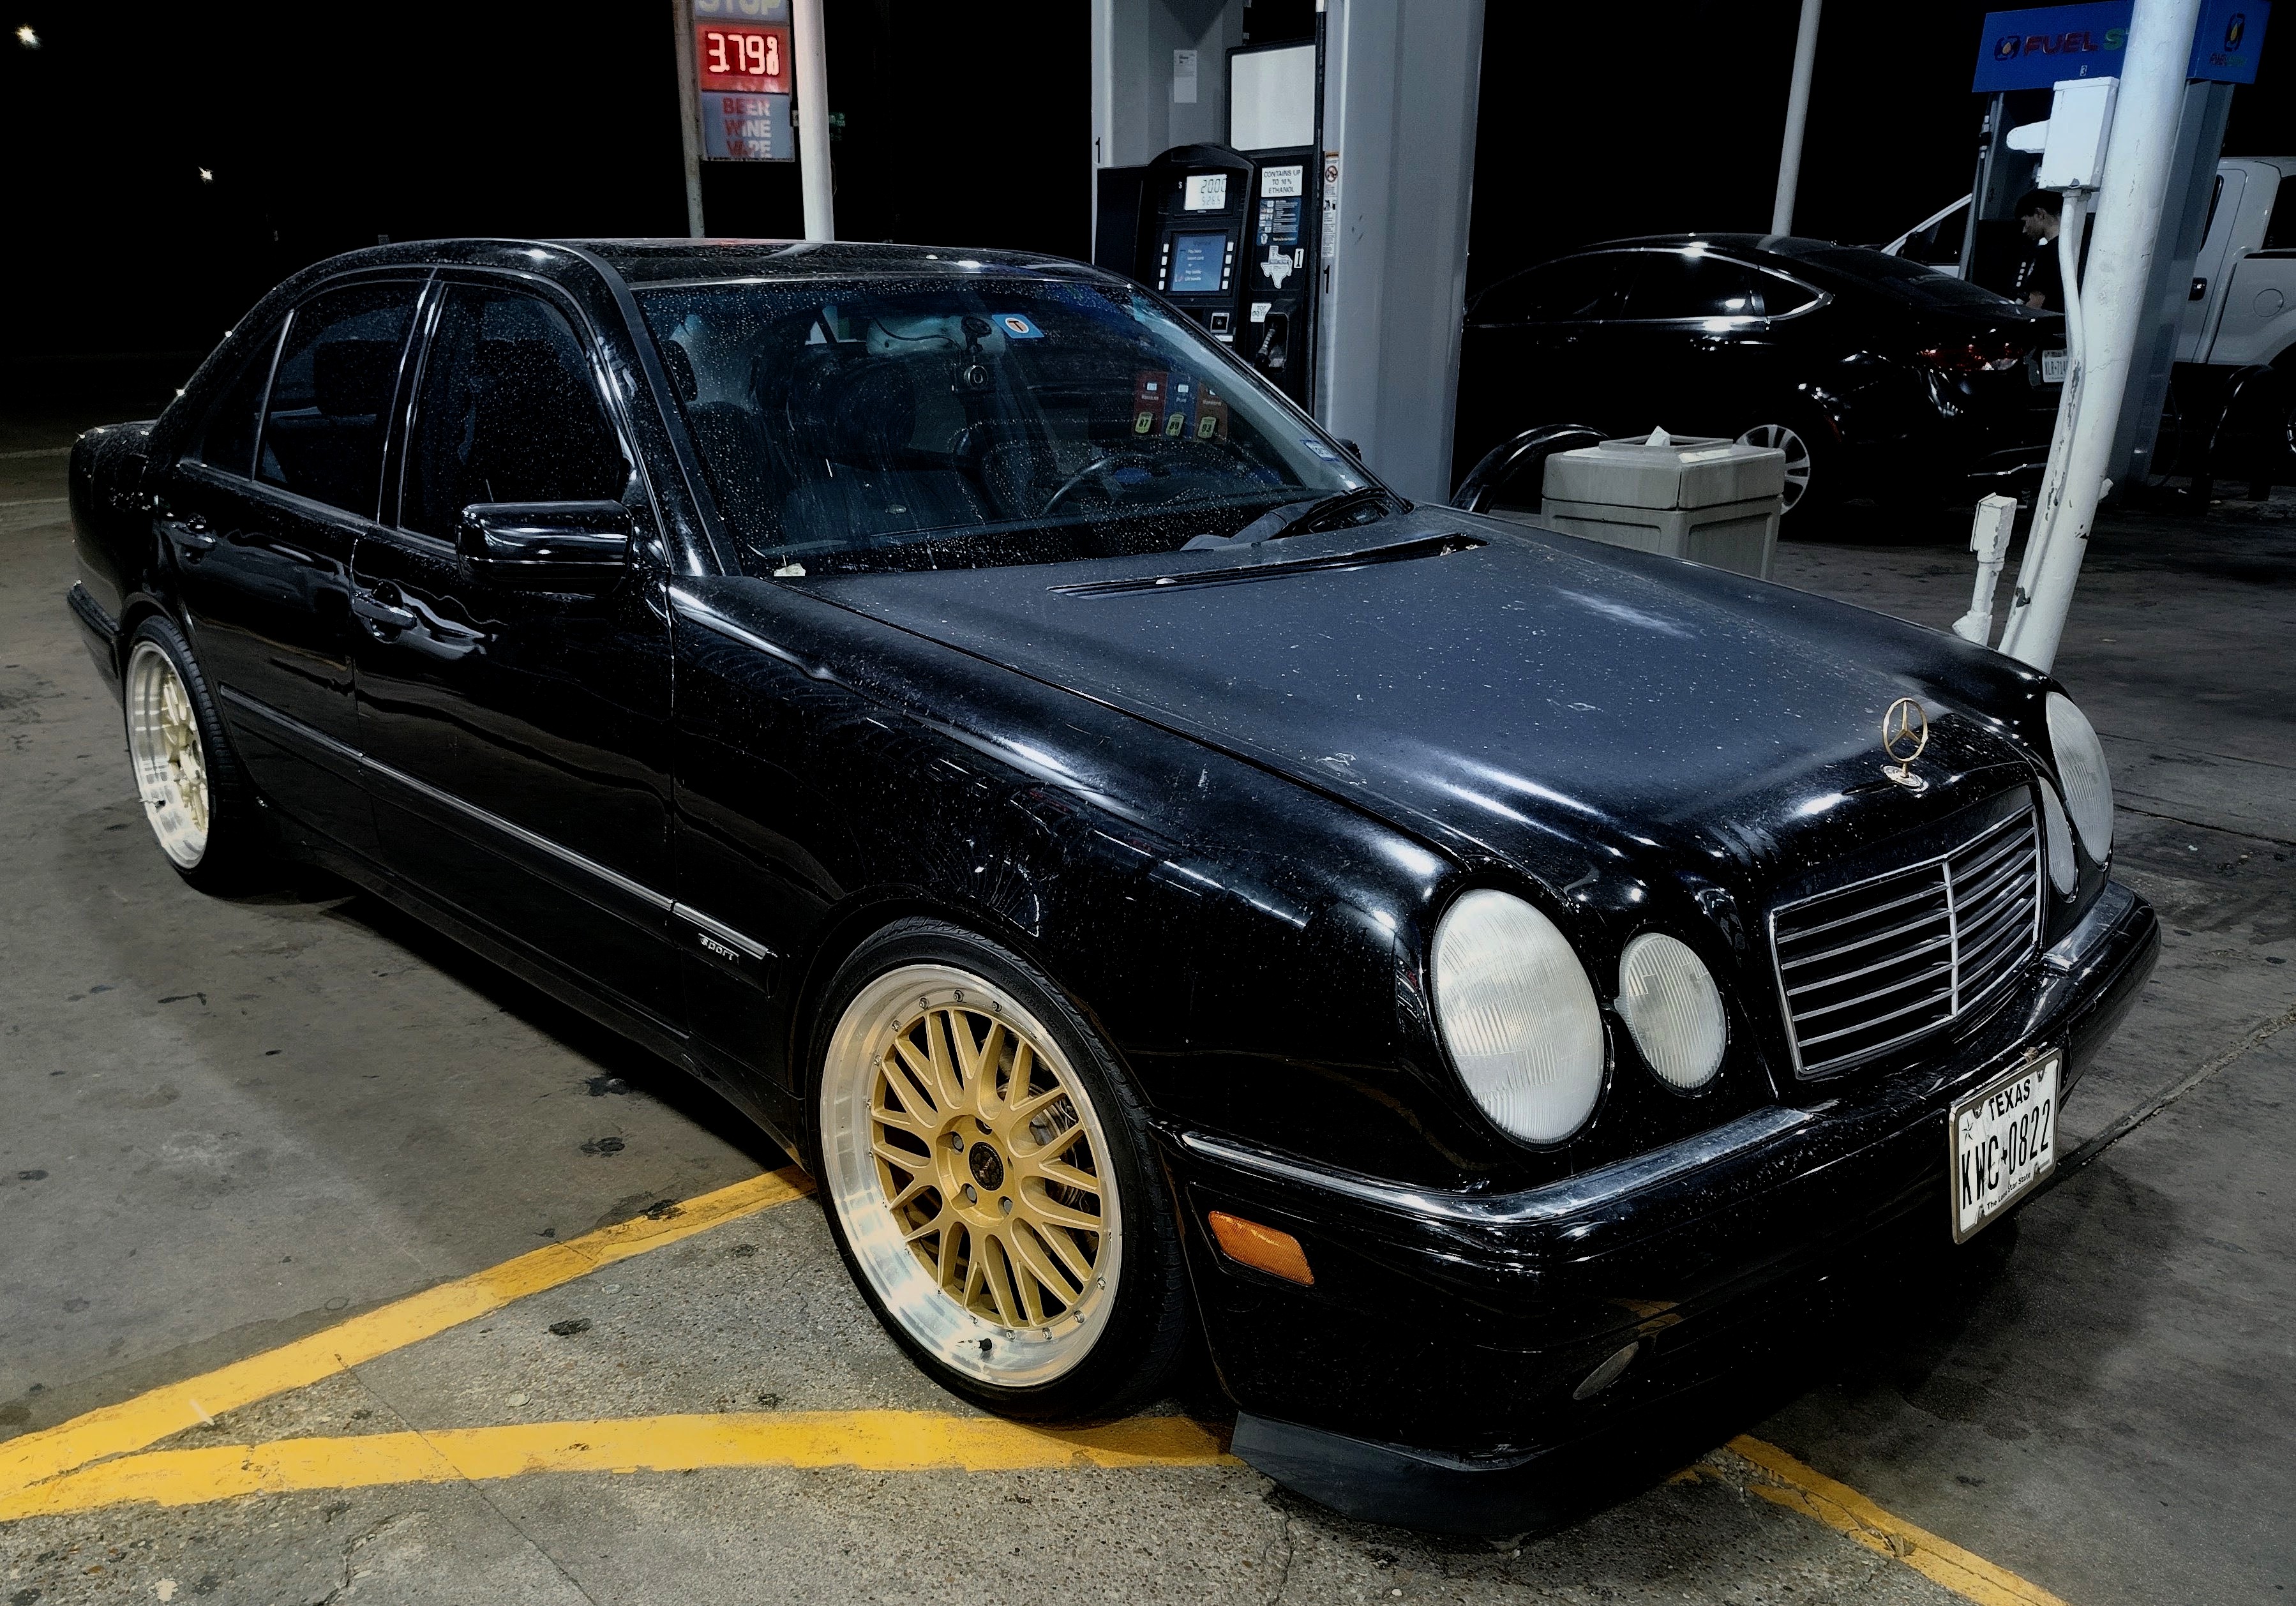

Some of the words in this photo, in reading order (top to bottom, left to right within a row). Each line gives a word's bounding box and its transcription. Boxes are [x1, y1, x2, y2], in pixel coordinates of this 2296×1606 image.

[2024, 31, 2099, 56] FUEL
[723, 97, 771, 116] BEER
[724, 119, 772, 138] WINE
[1264, 169, 1291, 178] CONTAINS
[1295, 250, 1301, 267] 1
[1323, 265, 1330, 294] 1
[1139, 419, 1149, 428] 87
[1169, 422, 1179, 430] 89
[1988, 1078, 2030, 1121] TEXAS
[1987, 1199, 1997, 1210] The
[2008, 1182, 2017, 1193] Star
[2018, 1173, 2031, 1185] State
